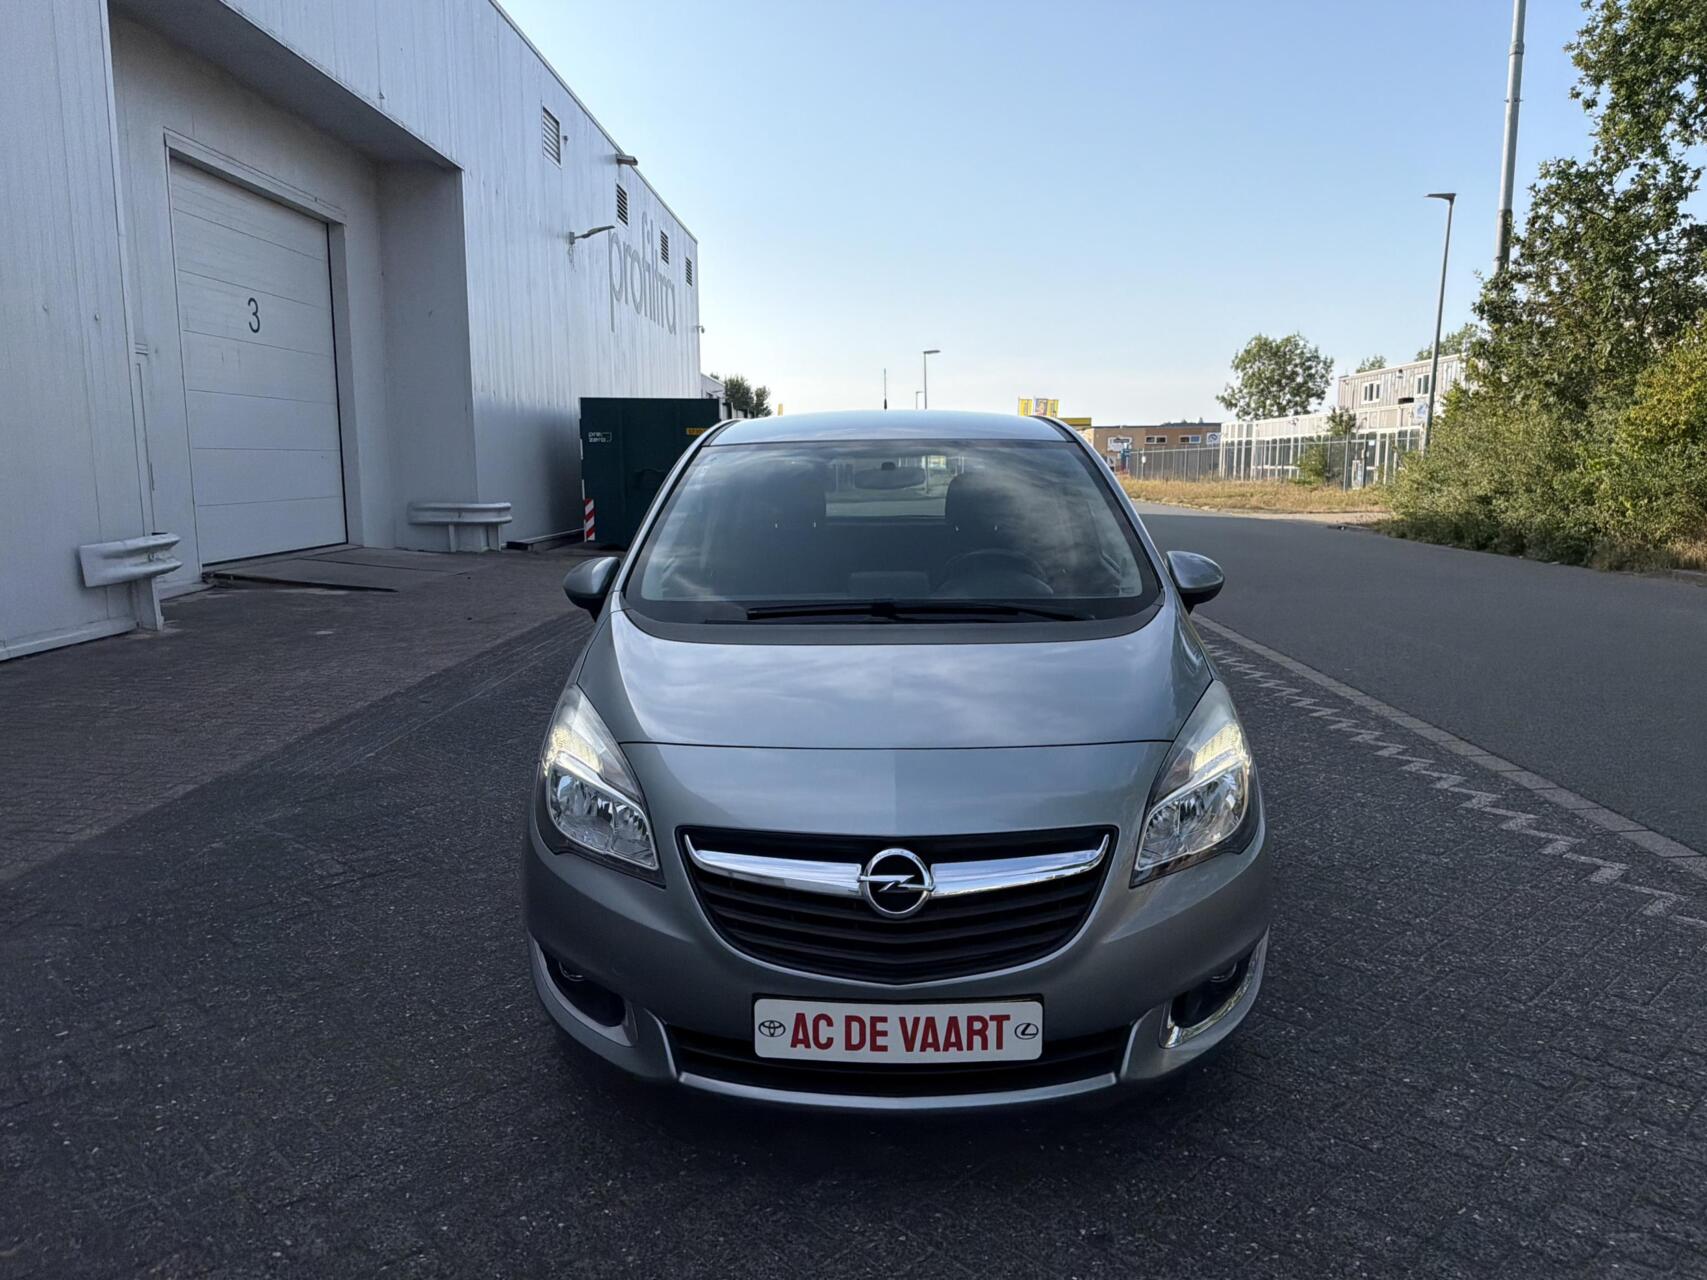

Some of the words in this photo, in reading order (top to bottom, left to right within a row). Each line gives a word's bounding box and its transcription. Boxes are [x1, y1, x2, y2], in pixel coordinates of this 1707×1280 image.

[248, 297, 260, 333] 3
[790, 1012, 834, 1050] AC
[844, 1015, 888, 1052] DE
[899, 1014, 1011, 1053] VAART
